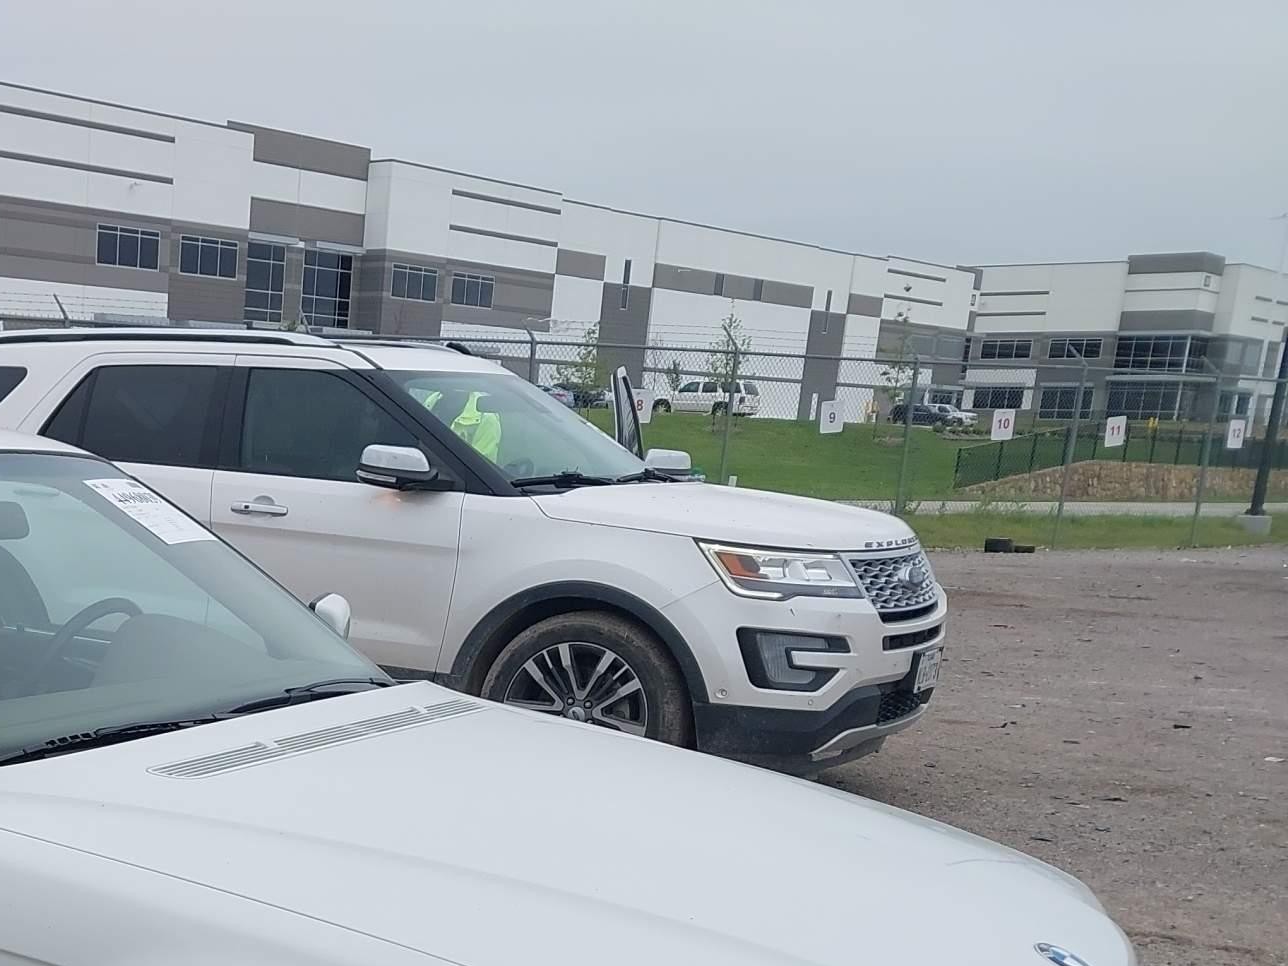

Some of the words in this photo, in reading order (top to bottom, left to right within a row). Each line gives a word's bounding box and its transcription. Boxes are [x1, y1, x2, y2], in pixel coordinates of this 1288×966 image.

[636, 399, 644, 411] 8
[829, 411, 836, 424] 9
[998, 418, 1010, 430] 10
[1110, 425, 1121, 436] 11
[1232, 428, 1241, 439] 12
